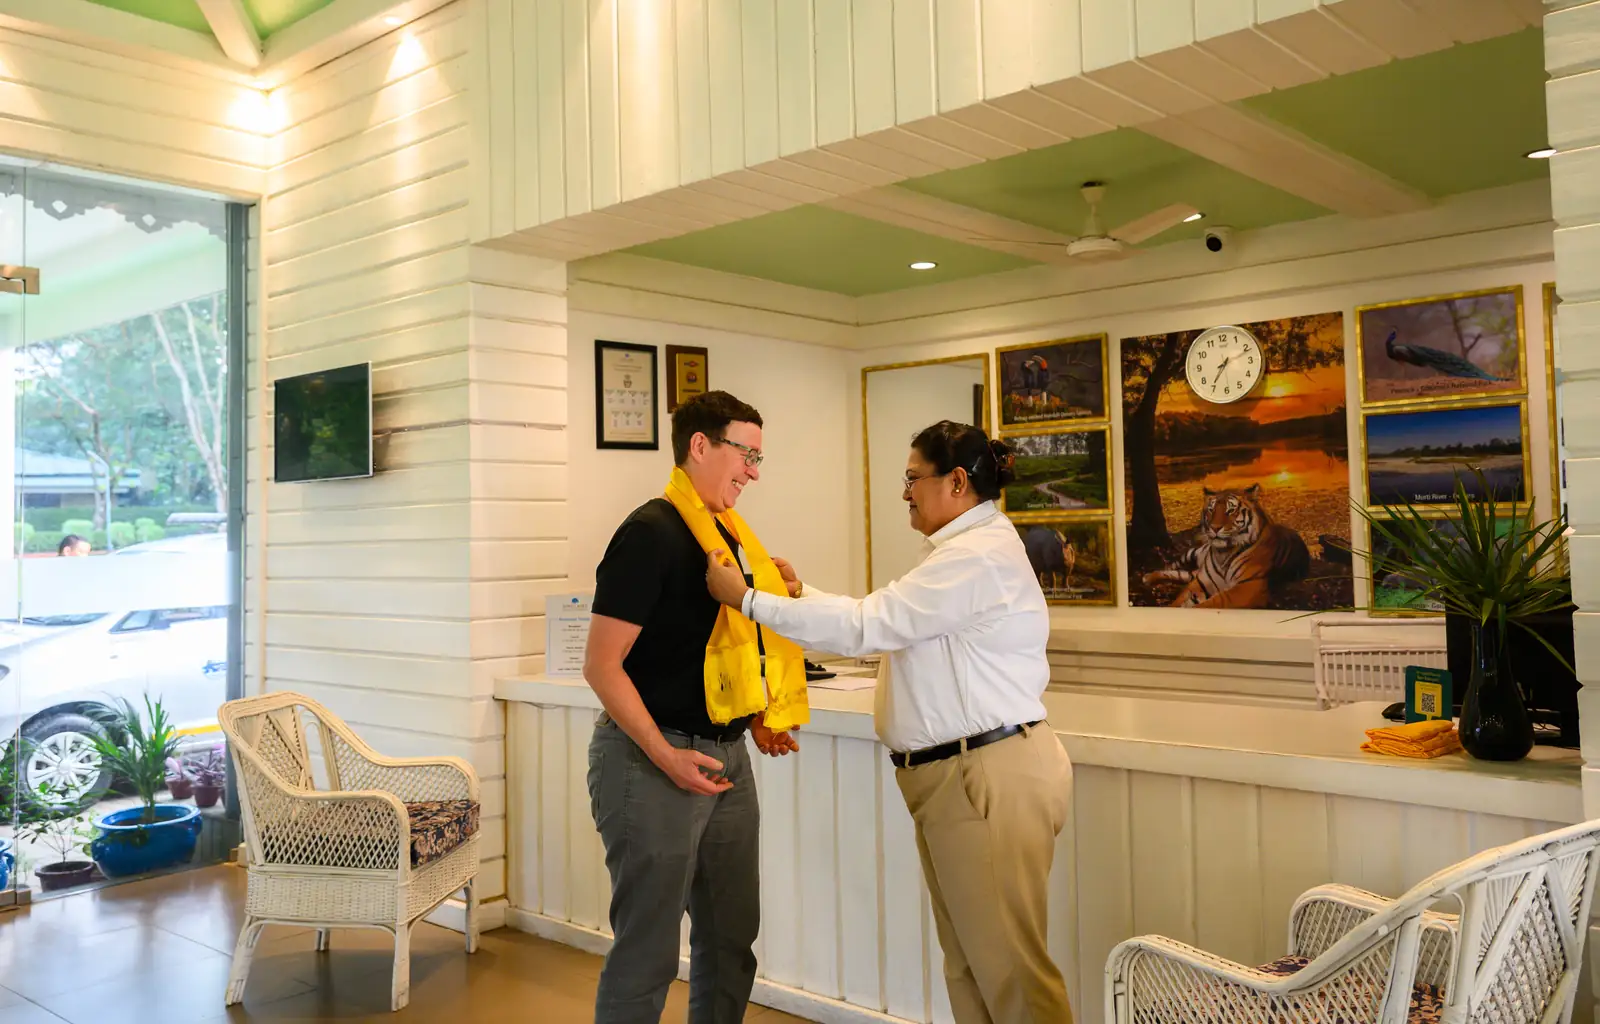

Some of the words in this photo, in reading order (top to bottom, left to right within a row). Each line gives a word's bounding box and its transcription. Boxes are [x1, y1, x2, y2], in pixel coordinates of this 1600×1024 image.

[1218, 334, 1227, 342] 12
[1207, 340, 1214, 348] 11
[1243, 344, 1249, 352] 2
[1198, 351, 1207, 359] 10
[1211, 385, 1216, 393] 7
[1236, 381, 1242, 389] 5
[1224, 386, 1230, 394] 6
